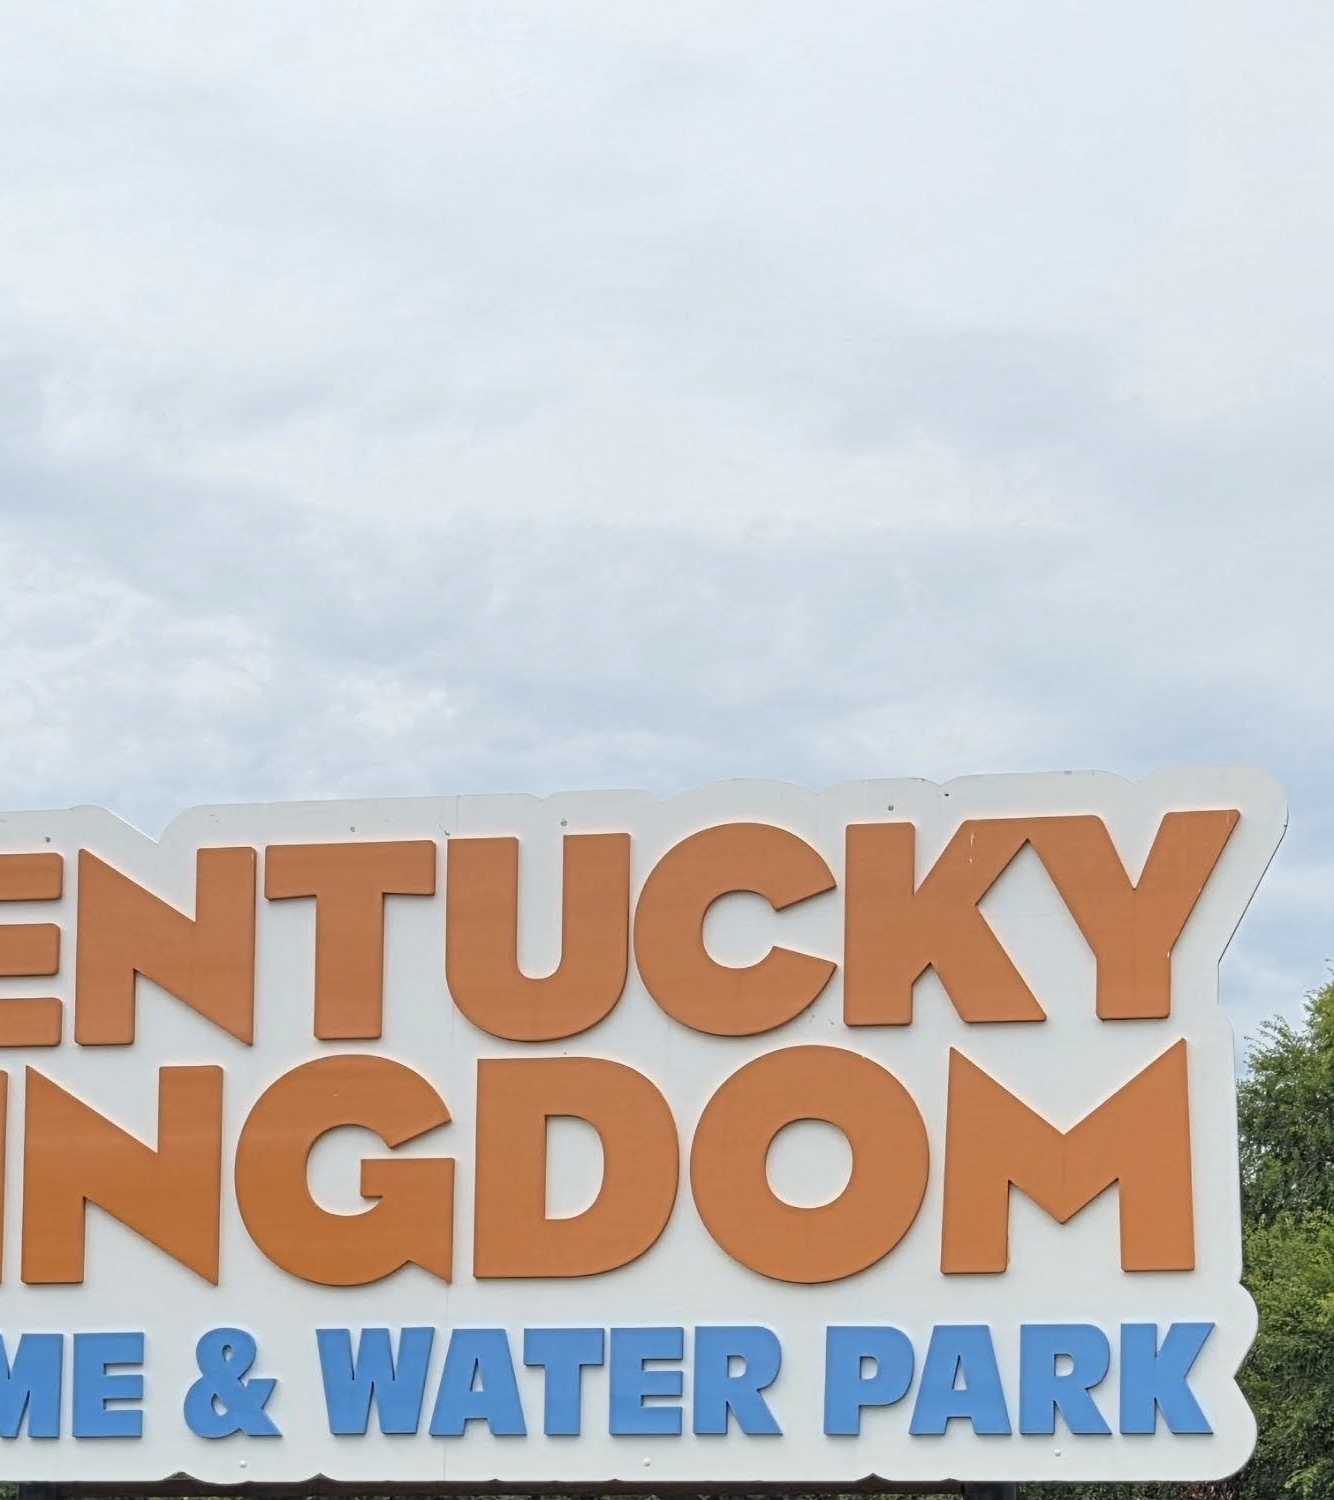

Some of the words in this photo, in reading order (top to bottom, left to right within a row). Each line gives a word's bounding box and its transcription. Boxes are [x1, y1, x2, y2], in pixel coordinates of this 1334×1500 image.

[183, 1326, 279, 1438] &
[316, 1326, 783, 1437] WATER
[822, 1321, 1215, 1435] PARK
